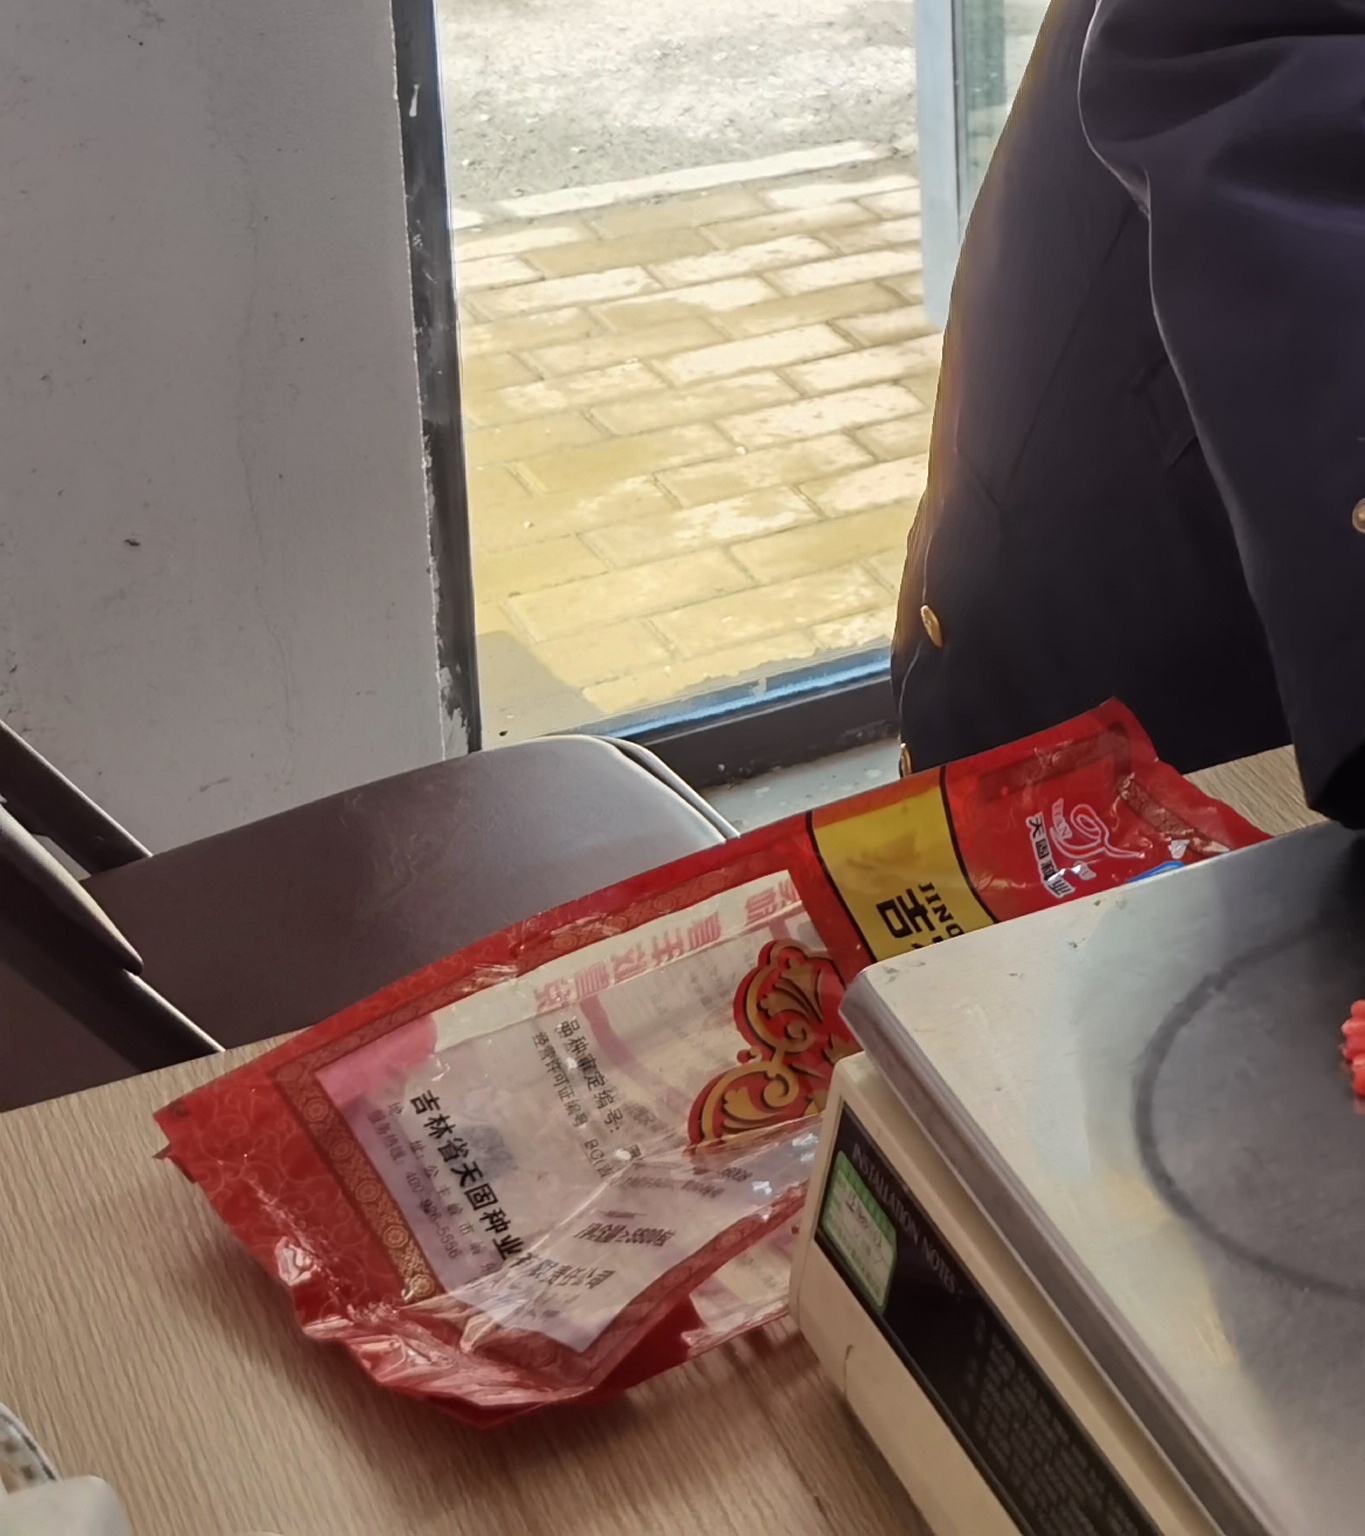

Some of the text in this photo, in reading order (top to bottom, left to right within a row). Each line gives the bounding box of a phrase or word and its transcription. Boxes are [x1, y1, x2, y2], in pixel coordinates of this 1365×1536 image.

[1027, 813, 1075, 898] 天固种业
[876, 888, 945, 950] 吉
